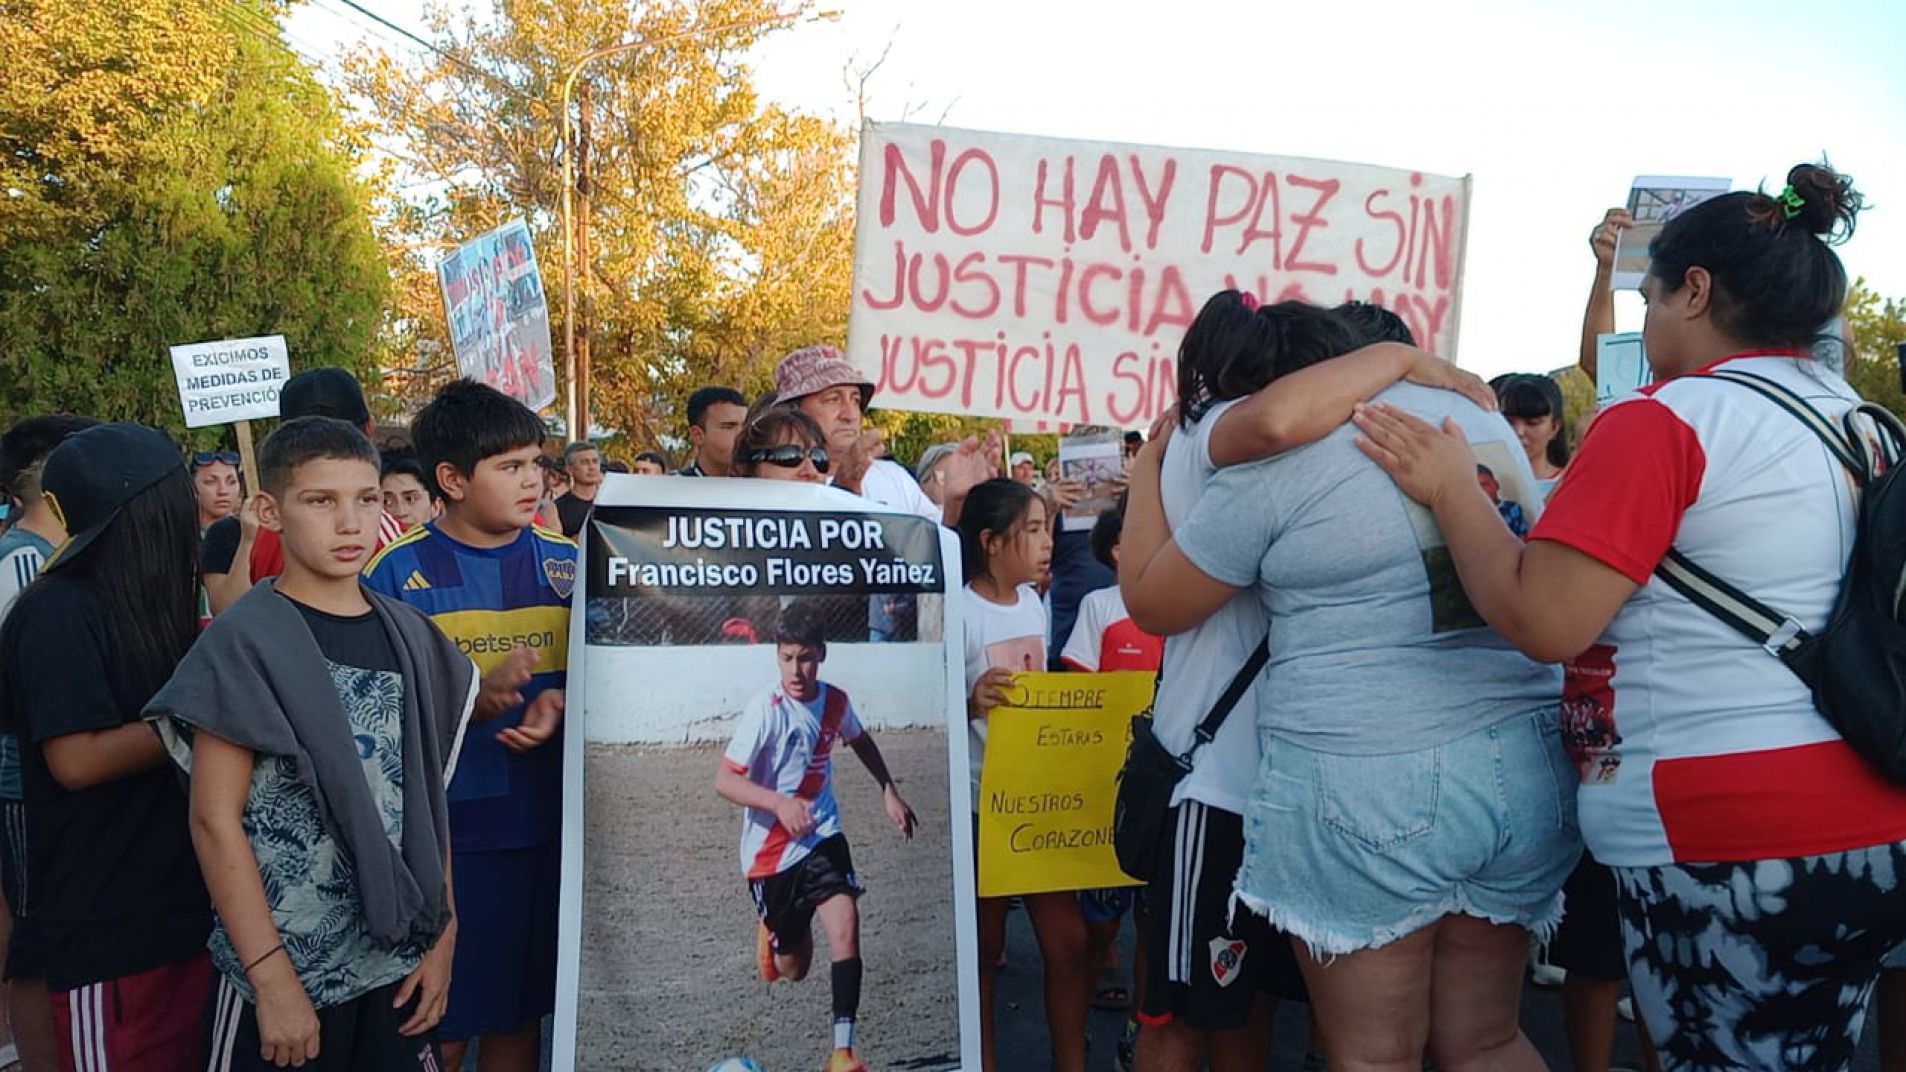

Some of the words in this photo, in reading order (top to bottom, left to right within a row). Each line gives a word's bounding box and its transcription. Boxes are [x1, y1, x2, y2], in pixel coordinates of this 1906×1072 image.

[879, 138, 1000, 236] NO
[1032, 153, 1177, 254] HAY
[1200, 163, 1341, 275] PAZ
[187, 370, 258, 390] MEDIDAS
[261, 367, 282, 380] DE
[188, 385, 281, 412] PREVENCIÓ
[662, 515, 812, 551] JUSTICIA
[819, 519, 884, 551] POR
[607, 556, 758, 587] Francisco
[766, 557, 855, 586] Flores
[858, 557, 936, 586] Yañez
[455, 630, 554, 654] betsson
[990, 789, 1085, 814] NUESTROS
[1010, 822, 1116, 854] CORAZONE
